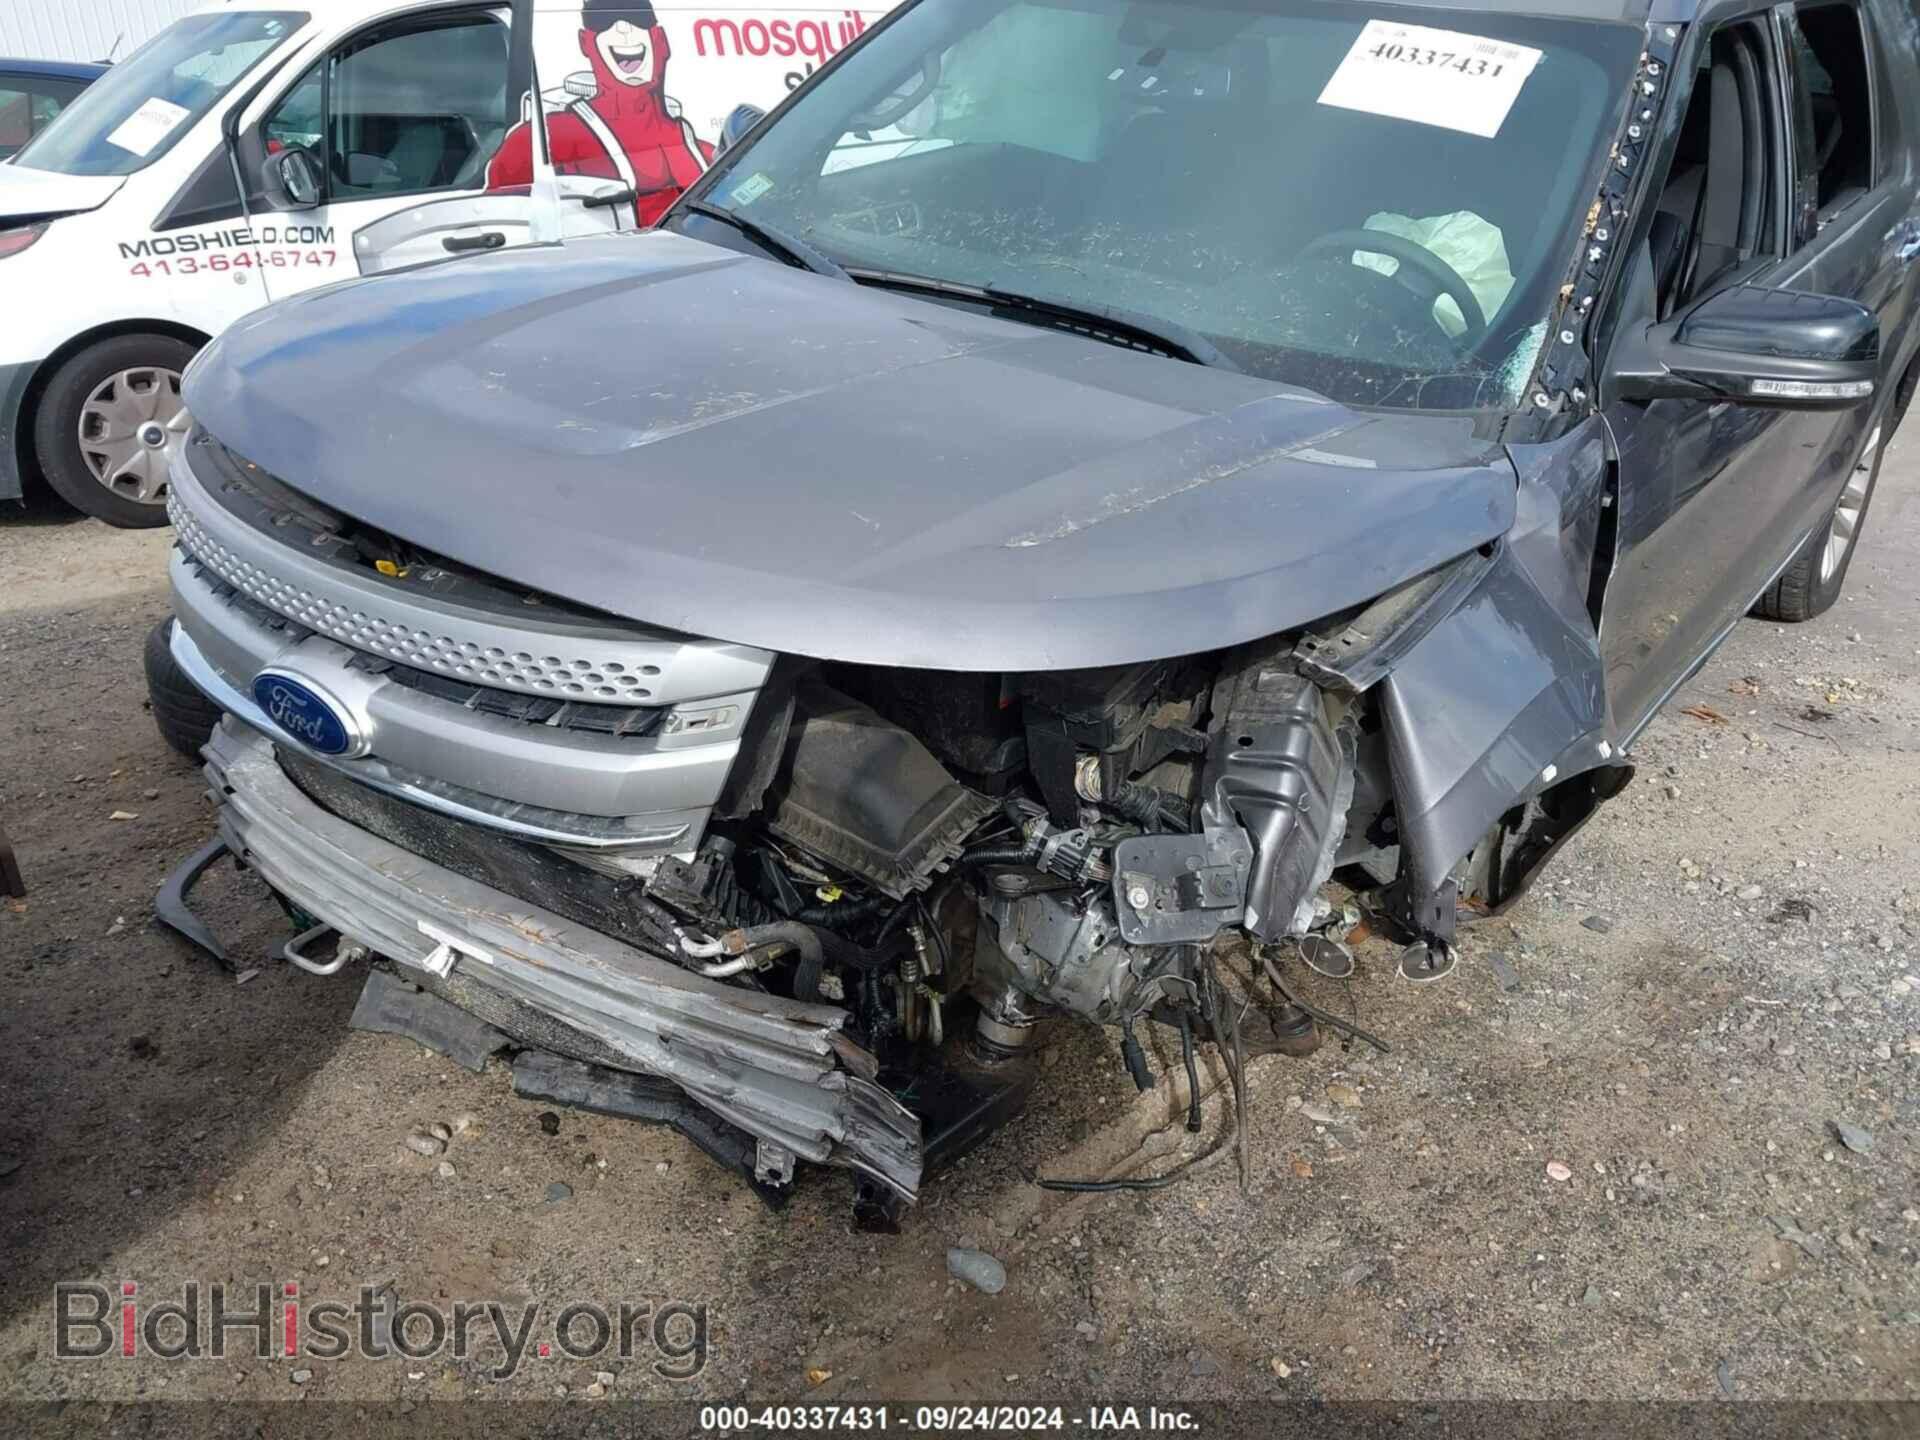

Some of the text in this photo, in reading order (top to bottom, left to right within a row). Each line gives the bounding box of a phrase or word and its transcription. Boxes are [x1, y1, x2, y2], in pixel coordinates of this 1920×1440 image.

[693, 9, 876, 64] mosquit
[1367, 42, 1504, 78] 40337431
[118, 226, 335, 259] MOSHIELD.COM
[270, 684, 325, 740] Ford
